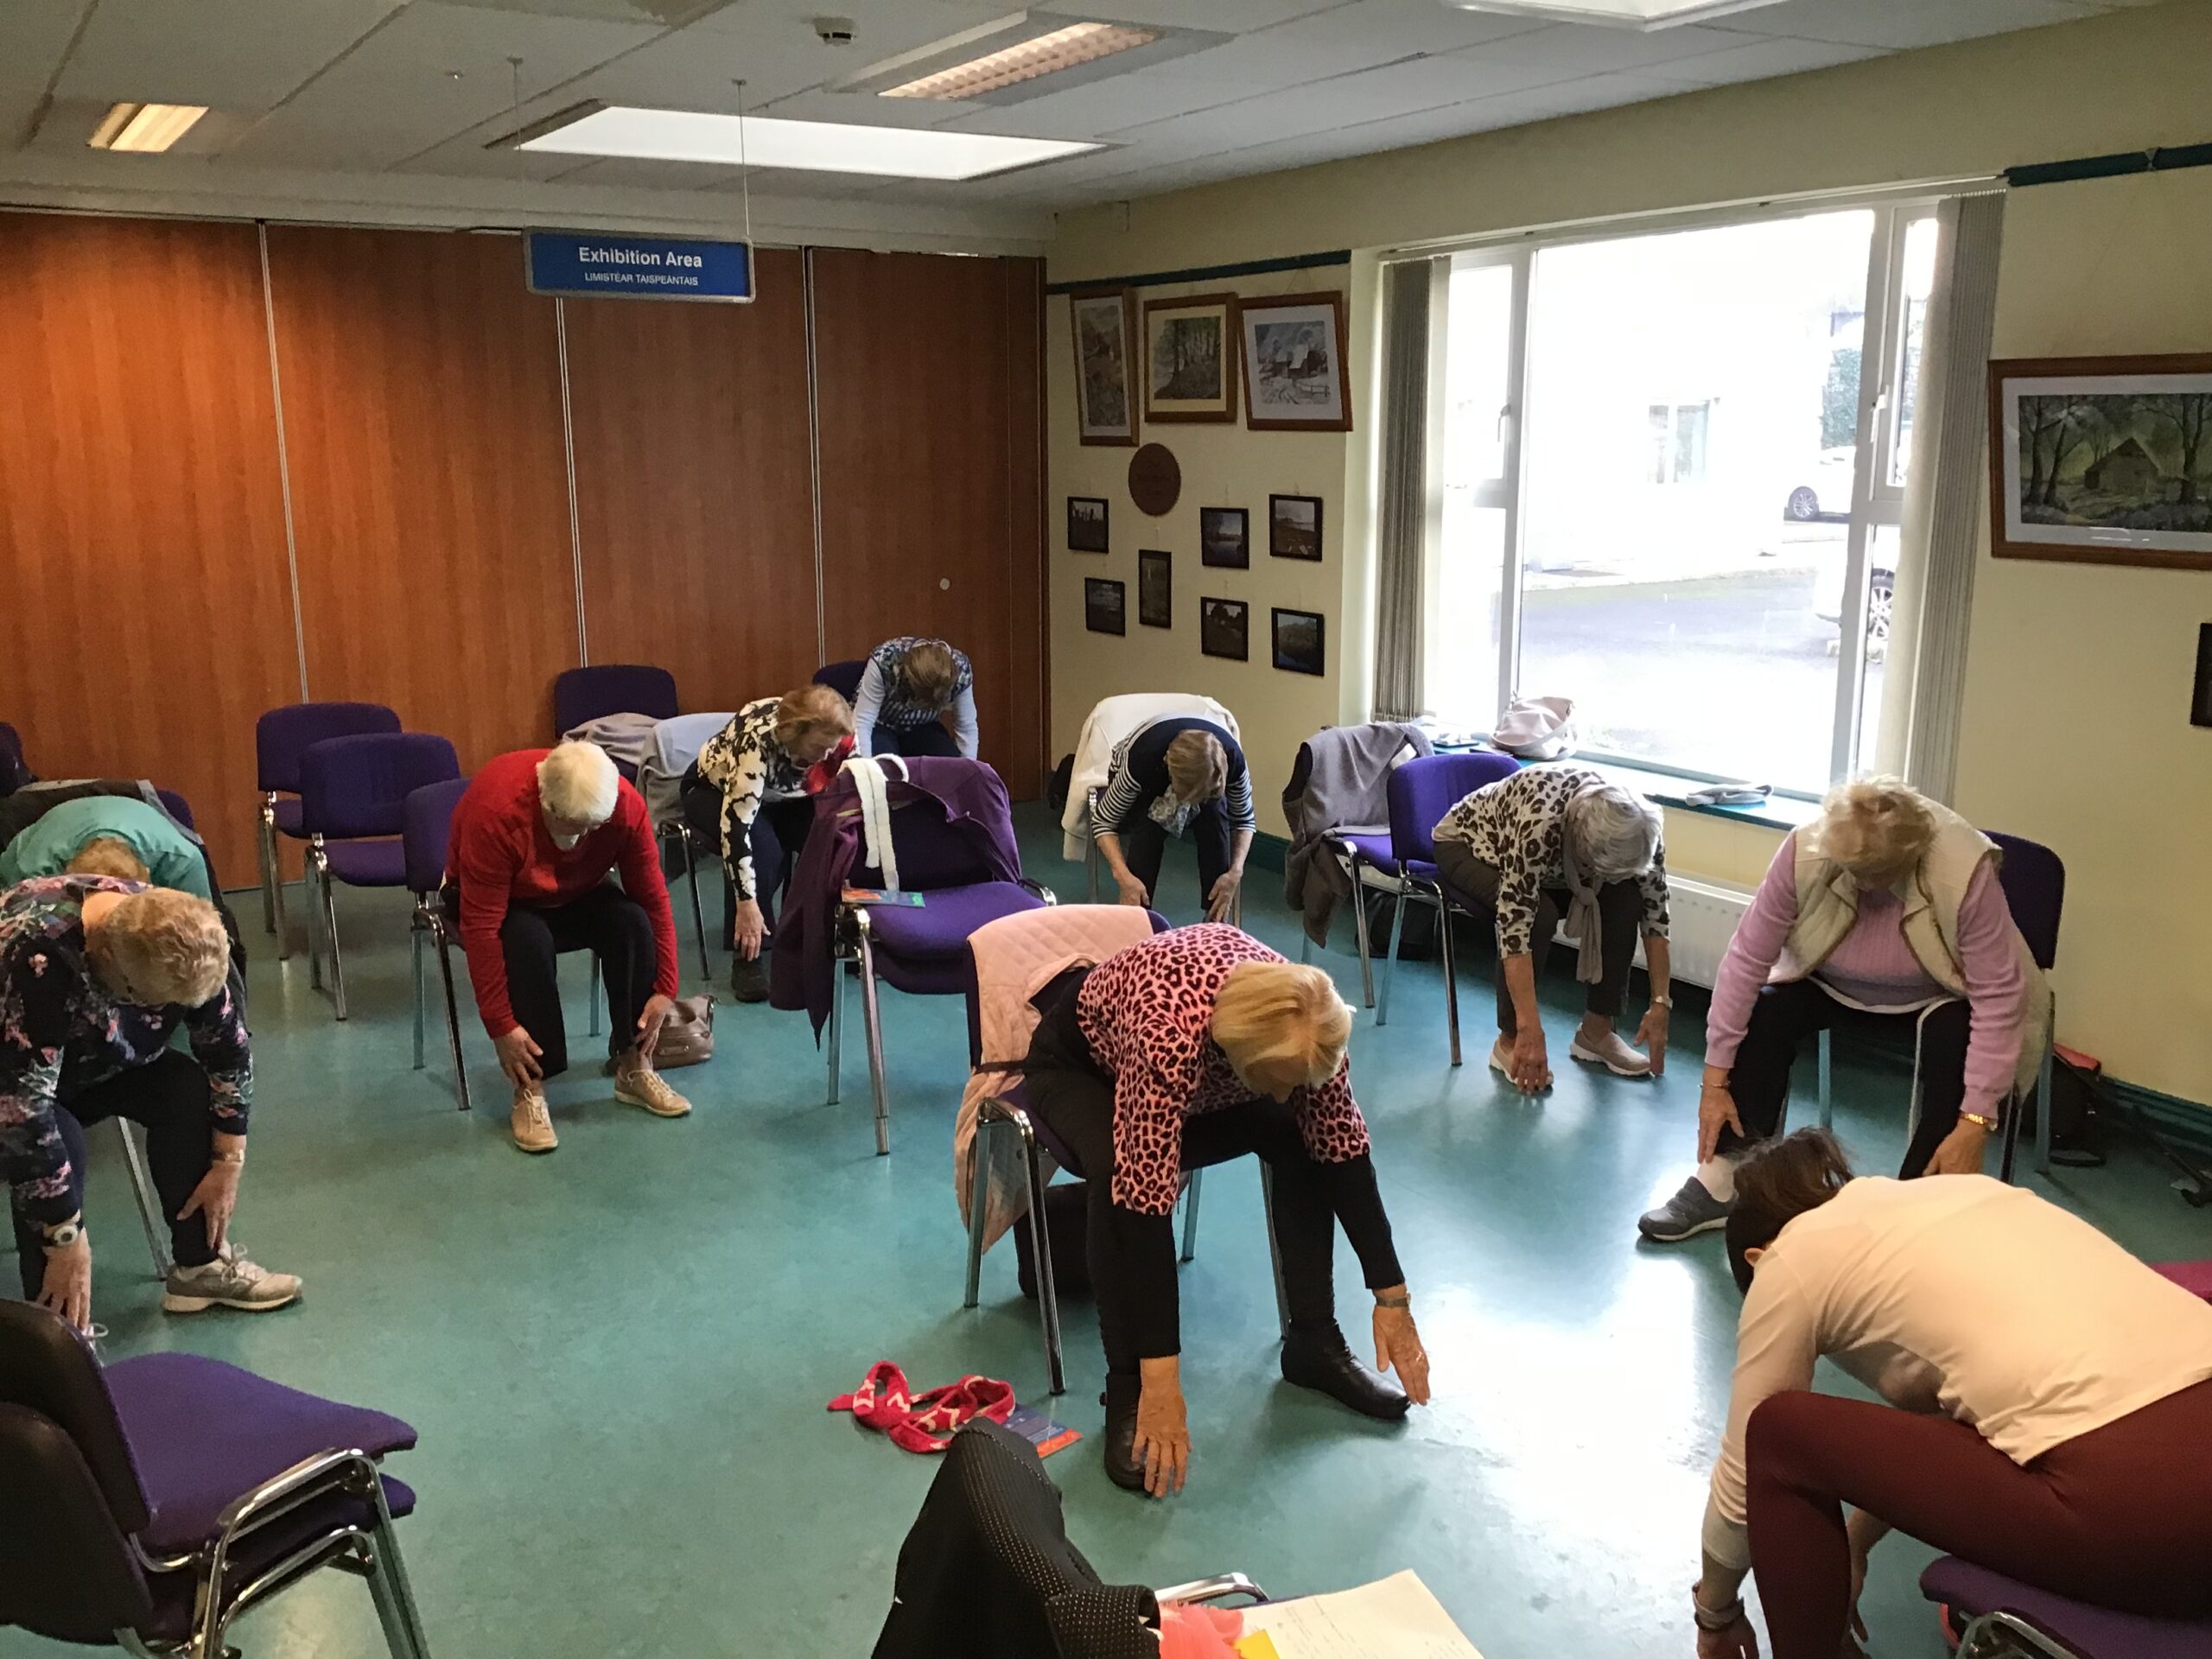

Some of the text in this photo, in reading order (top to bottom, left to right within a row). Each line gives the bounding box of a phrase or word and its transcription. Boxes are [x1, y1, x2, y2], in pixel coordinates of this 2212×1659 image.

[579, 246, 702, 267] Exhibition Area
[584, 271, 633, 283] LIMISTÉAR
